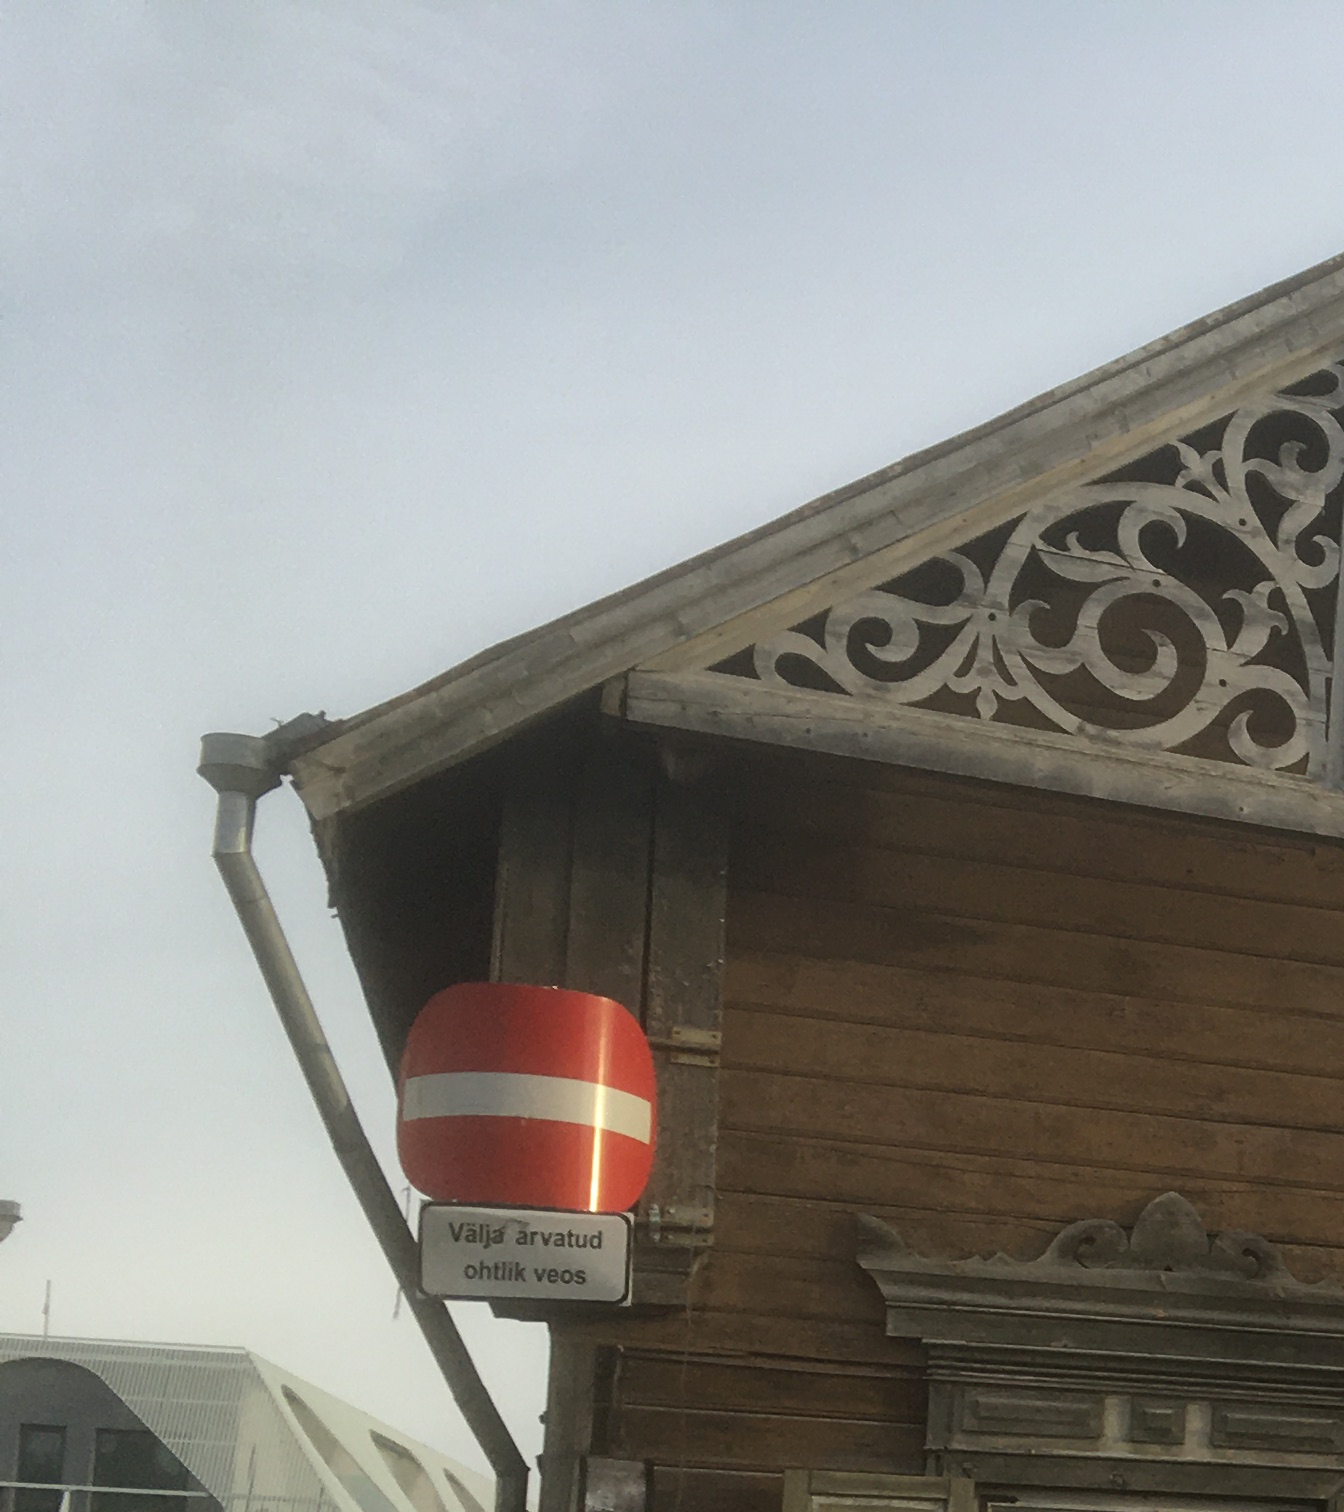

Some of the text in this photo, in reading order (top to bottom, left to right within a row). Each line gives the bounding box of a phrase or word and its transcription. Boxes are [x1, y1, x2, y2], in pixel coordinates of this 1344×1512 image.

[448, 1221, 603, 1250] Välja arvatud
[463, 1260, 587, 1286] ohtlik veos
